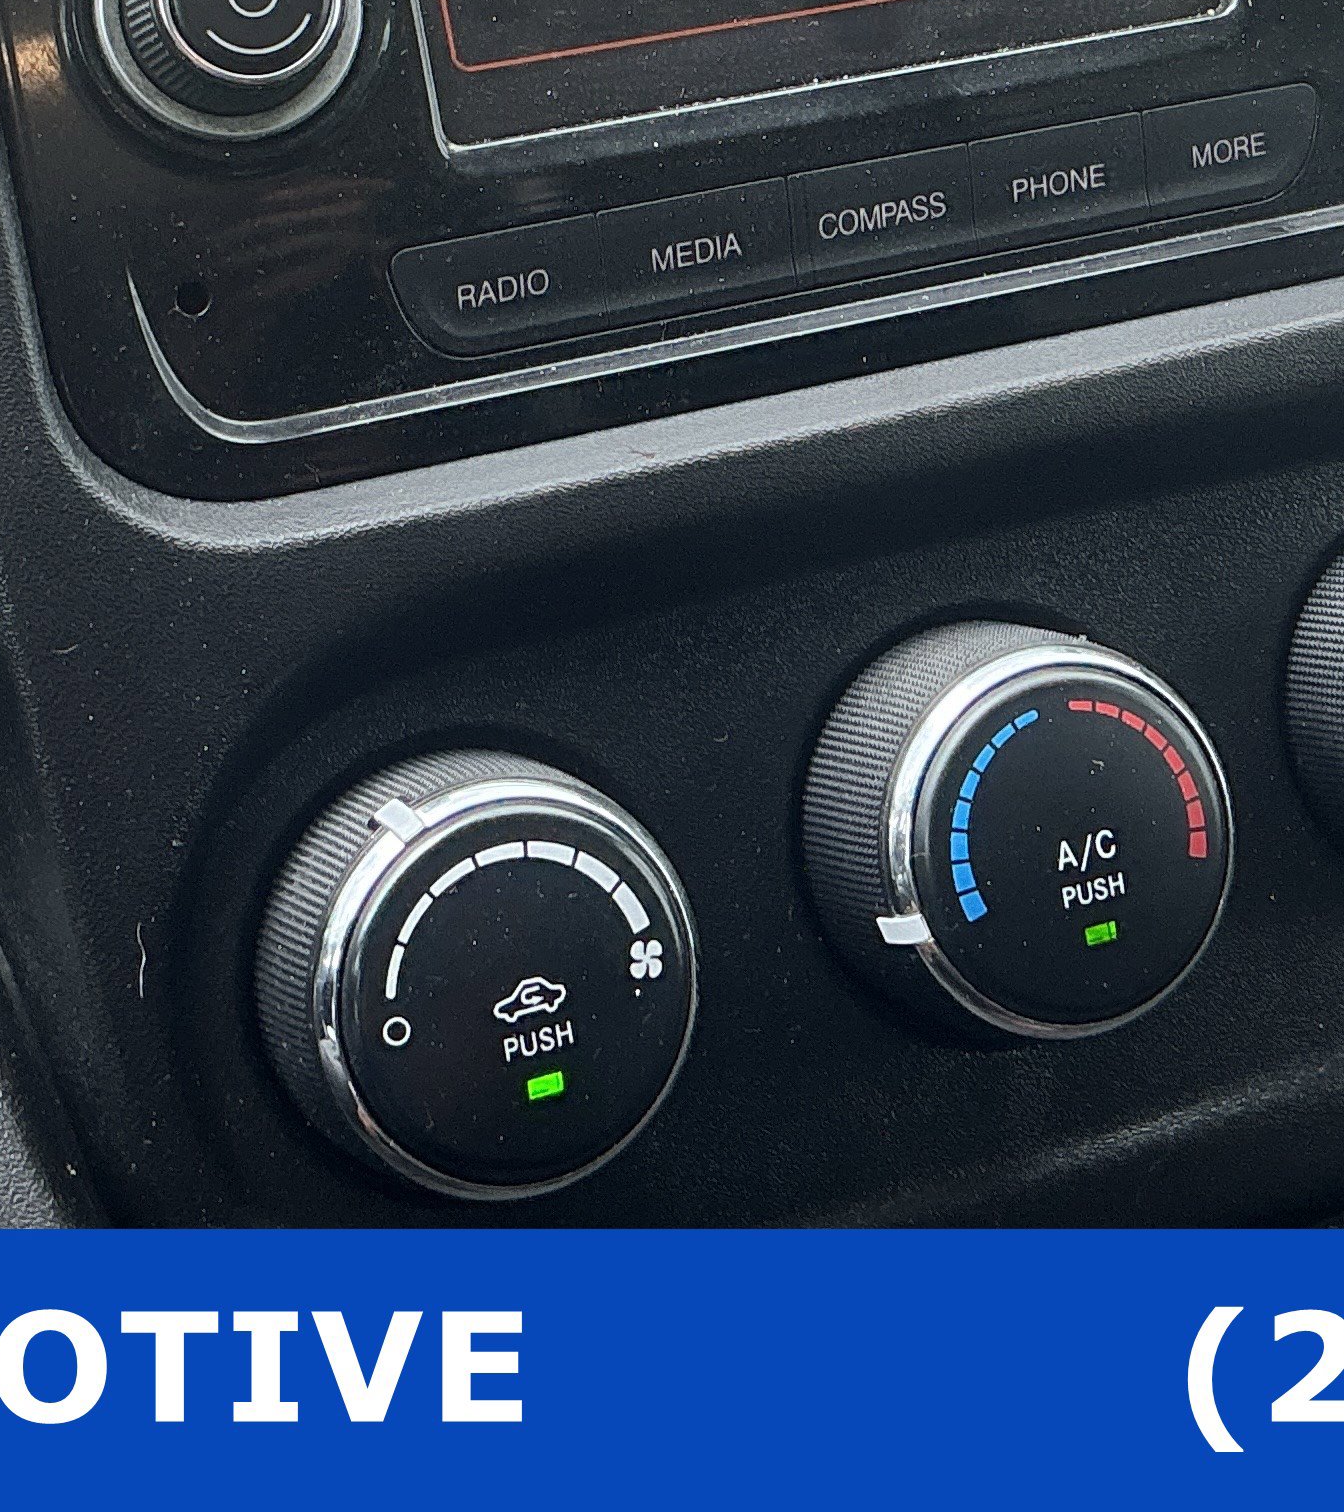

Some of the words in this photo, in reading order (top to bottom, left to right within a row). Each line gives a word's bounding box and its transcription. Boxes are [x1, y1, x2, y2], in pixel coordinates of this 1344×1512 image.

[1189, 131, 1268, 171] MORE
[1010, 162, 1107, 206] PHONE
[817, 190, 949, 242] COMPASS
[649, 233, 743, 275] MEDIA
[455, 268, 552, 312] RADIO
[1057, 828, 1118, 872] A/C
[1061, 871, 1126, 910] PUSH
[503, 1020, 575, 1063] PUSH
